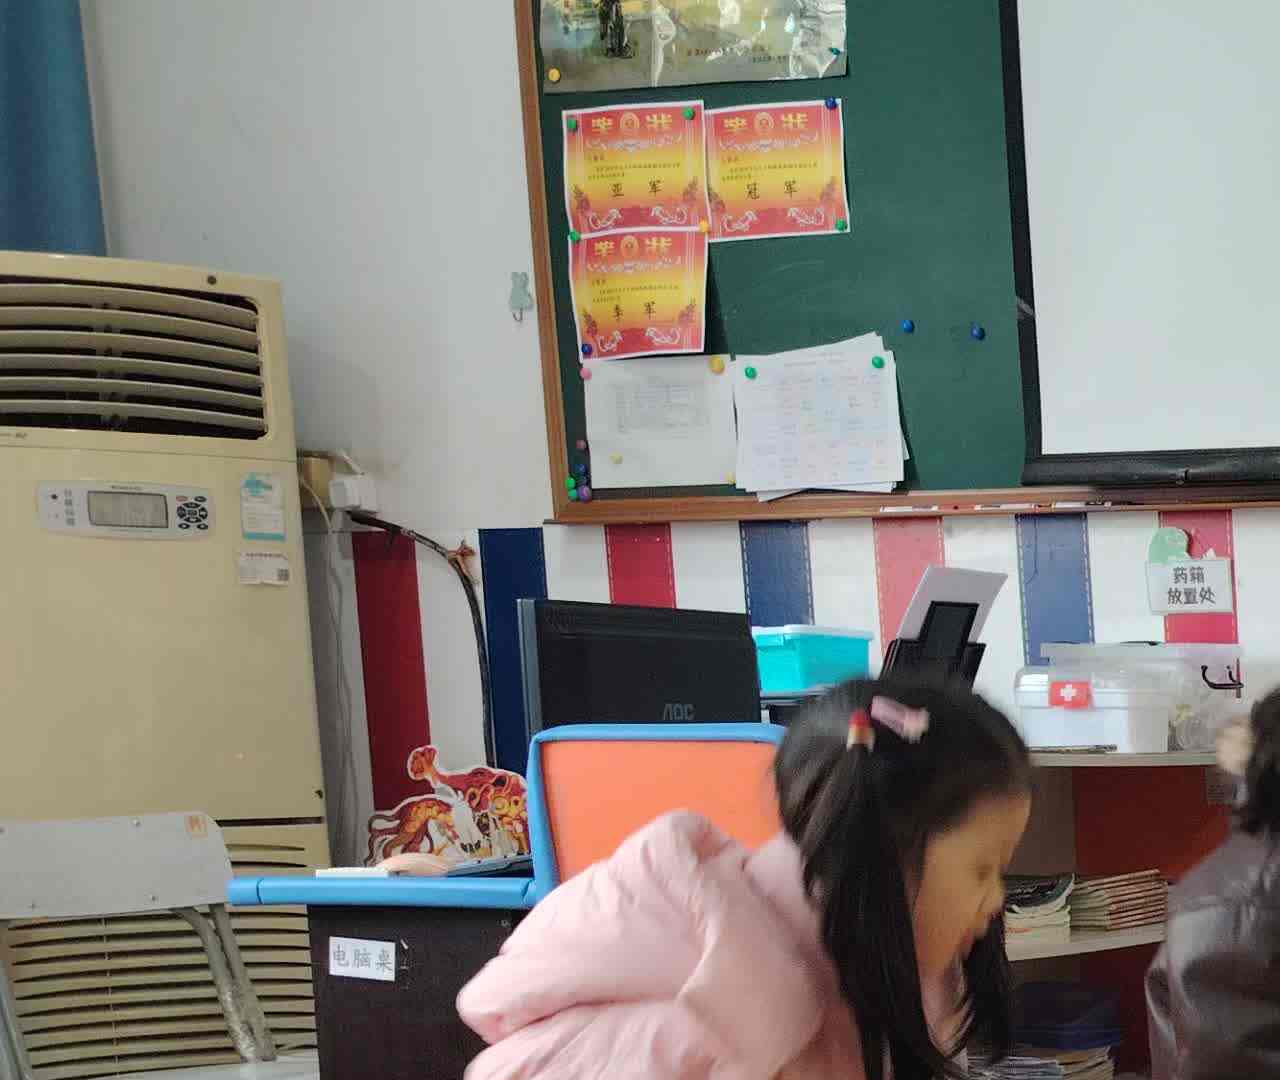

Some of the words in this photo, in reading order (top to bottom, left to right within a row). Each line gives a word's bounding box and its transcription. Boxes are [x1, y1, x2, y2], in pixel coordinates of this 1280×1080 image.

[1173, 566, 1205, 584] 药箱
[1168, 587, 1216, 605] 放置处
[663, 703, 695, 720] AOC
[333, 944, 393, 972] 电脑桌
